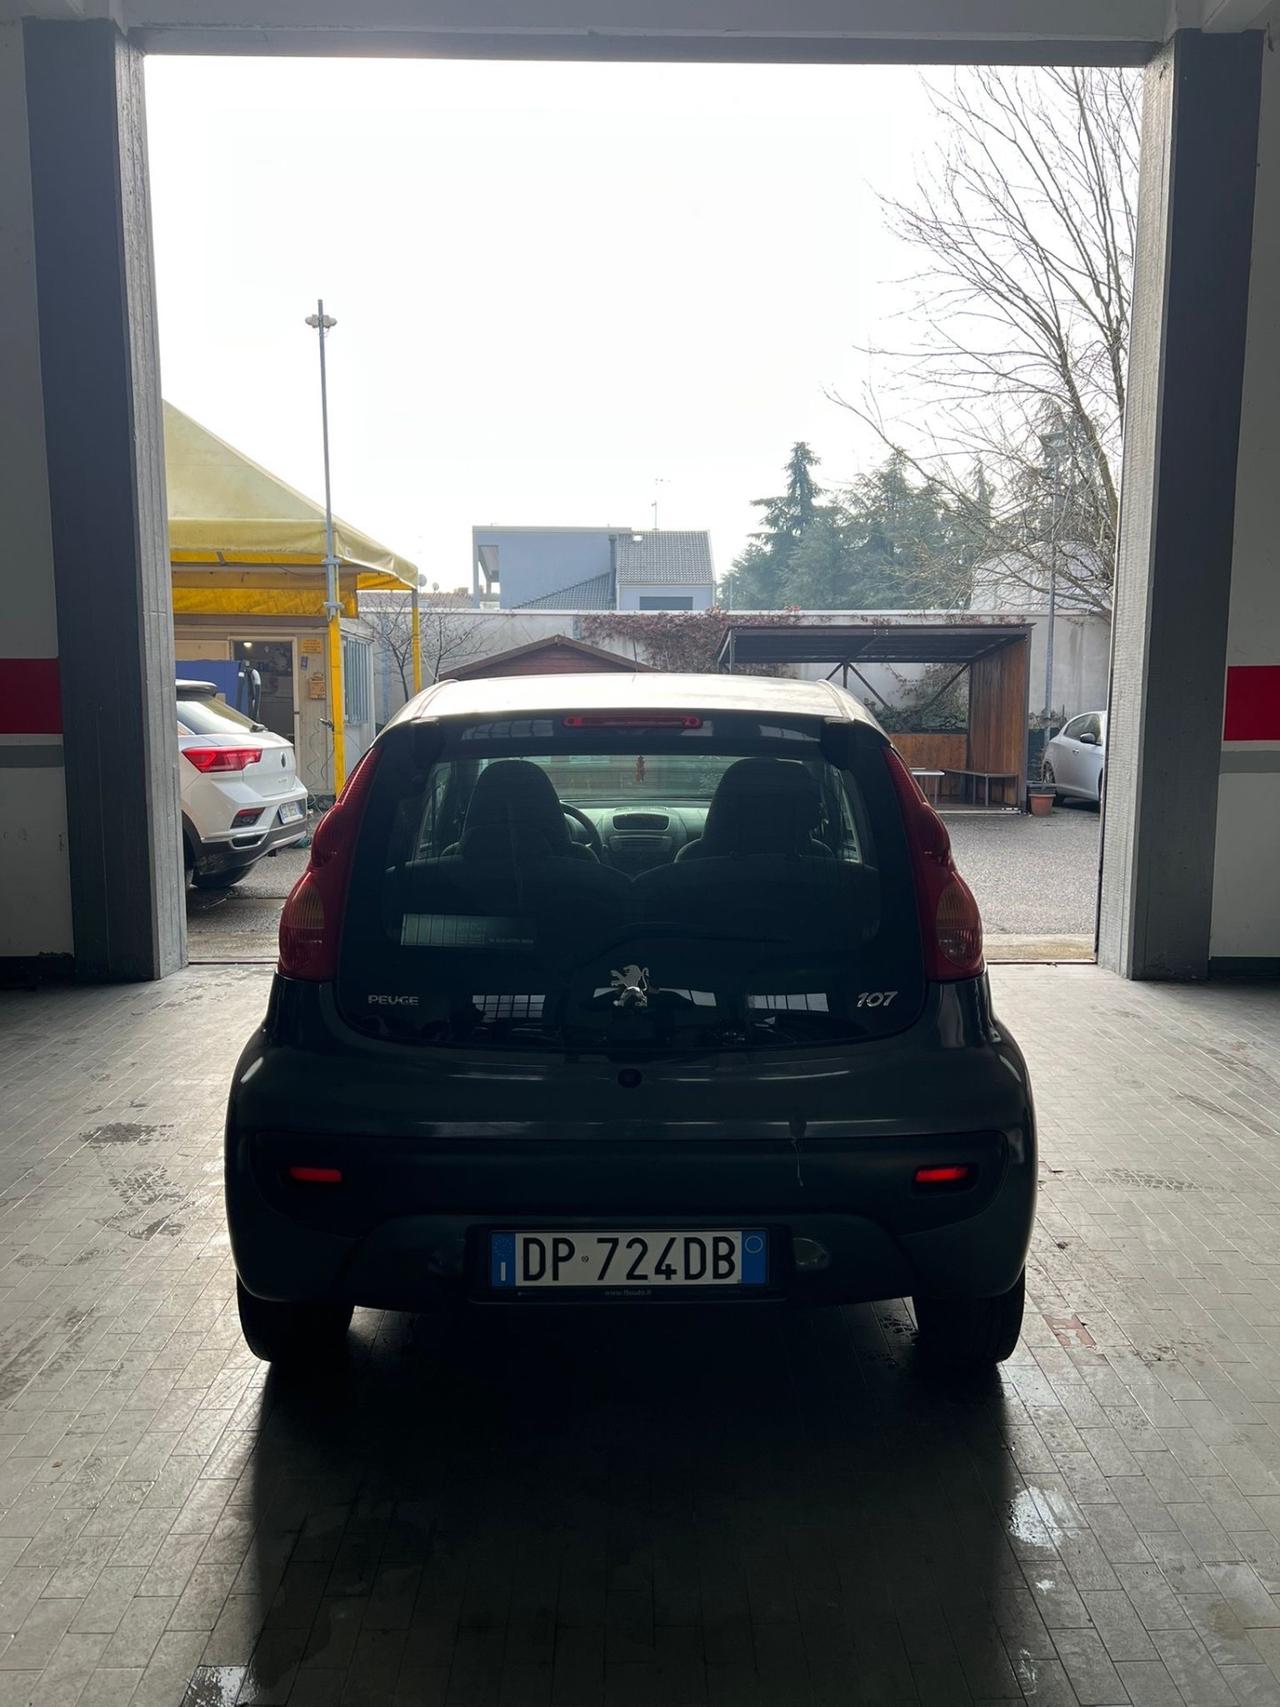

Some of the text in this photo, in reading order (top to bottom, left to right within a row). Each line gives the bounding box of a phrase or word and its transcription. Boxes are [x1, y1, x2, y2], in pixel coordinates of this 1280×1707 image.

[367, 994, 420, 1006] PEUGE
[856, 991, 898, 1007] 107
[523, 1236, 735, 1281] DP 724DB
